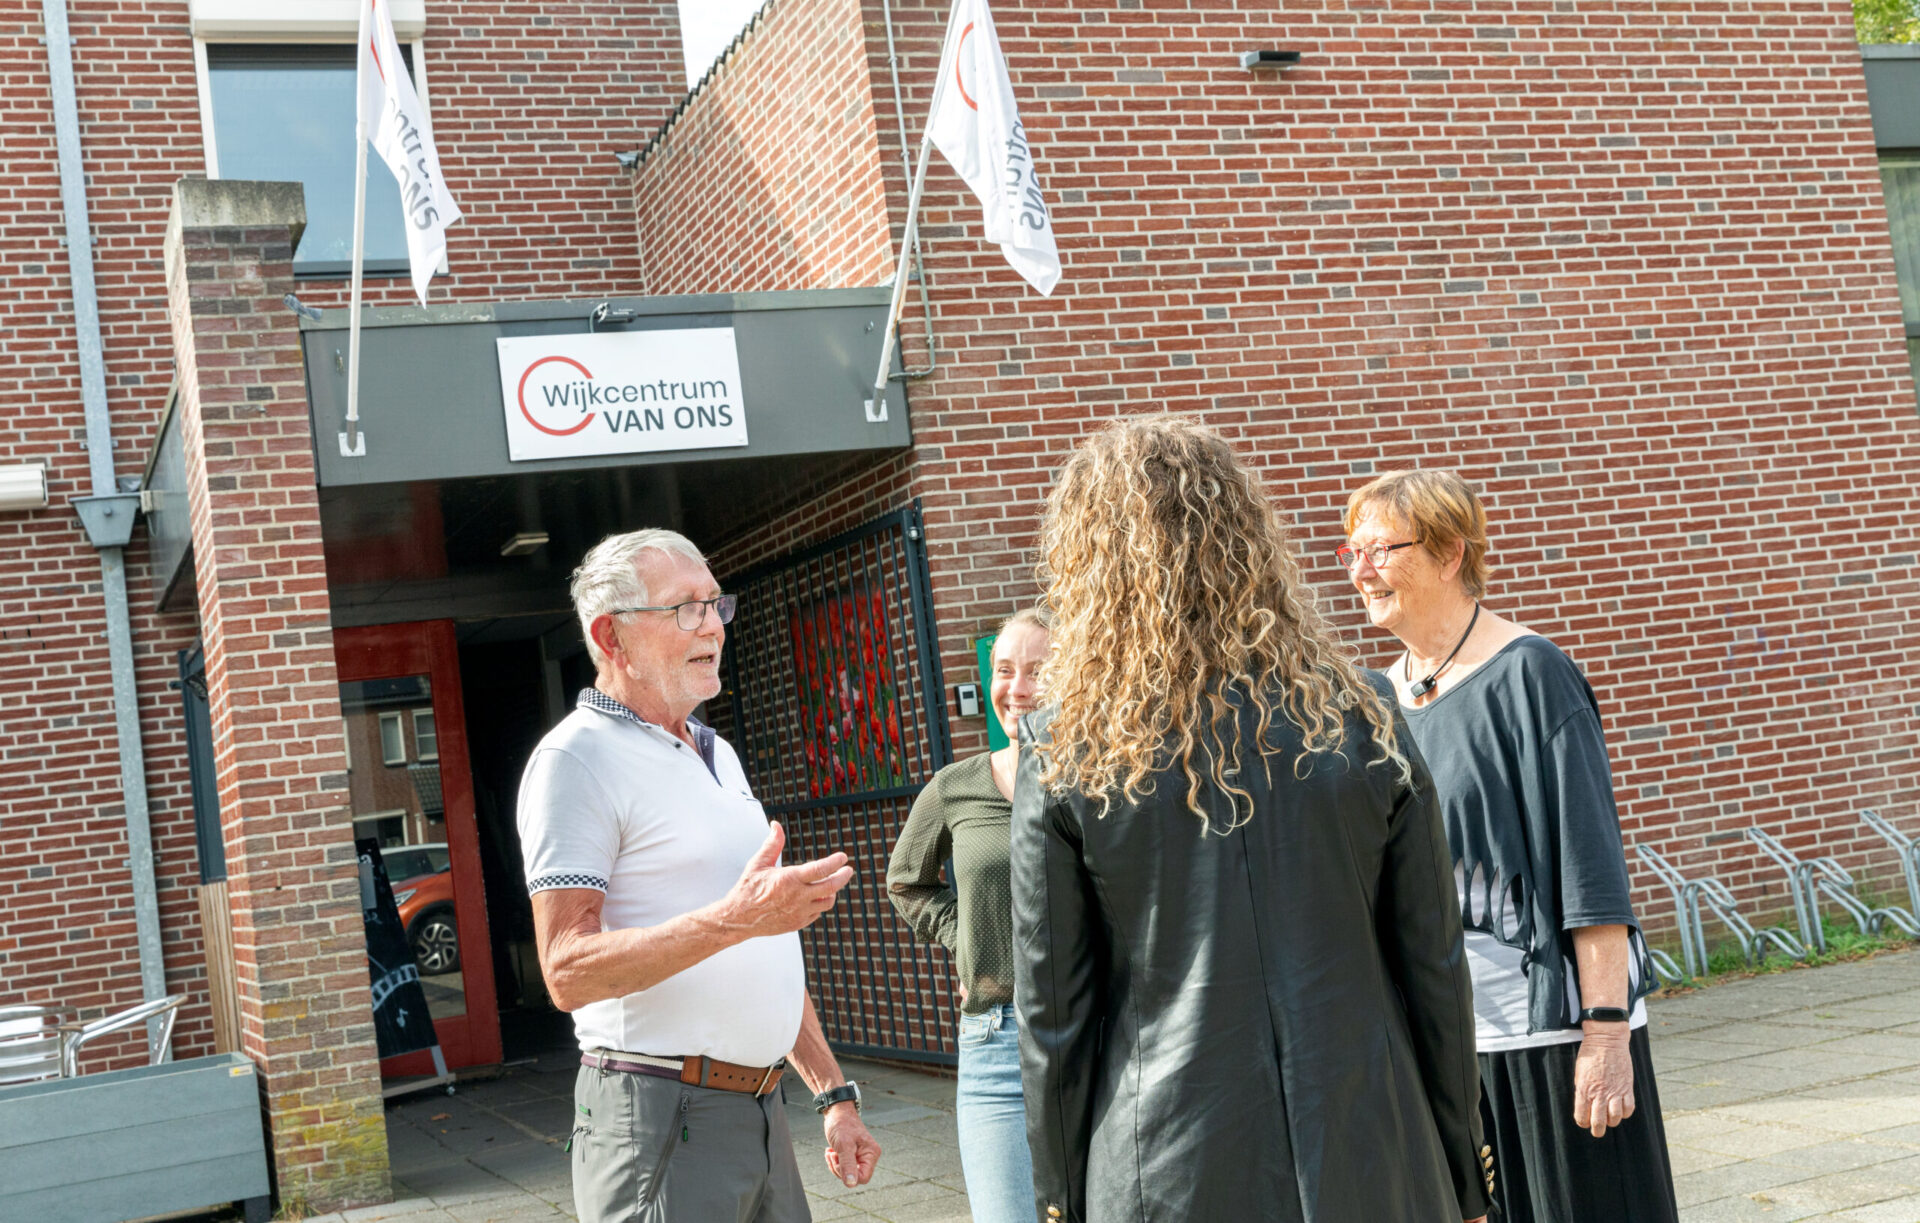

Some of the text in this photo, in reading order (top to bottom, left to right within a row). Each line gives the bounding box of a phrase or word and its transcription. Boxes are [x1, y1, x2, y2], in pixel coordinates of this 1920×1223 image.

[542, 379, 728, 413] Wijkcentrum
[603, 404, 734, 433] VAN ONS
